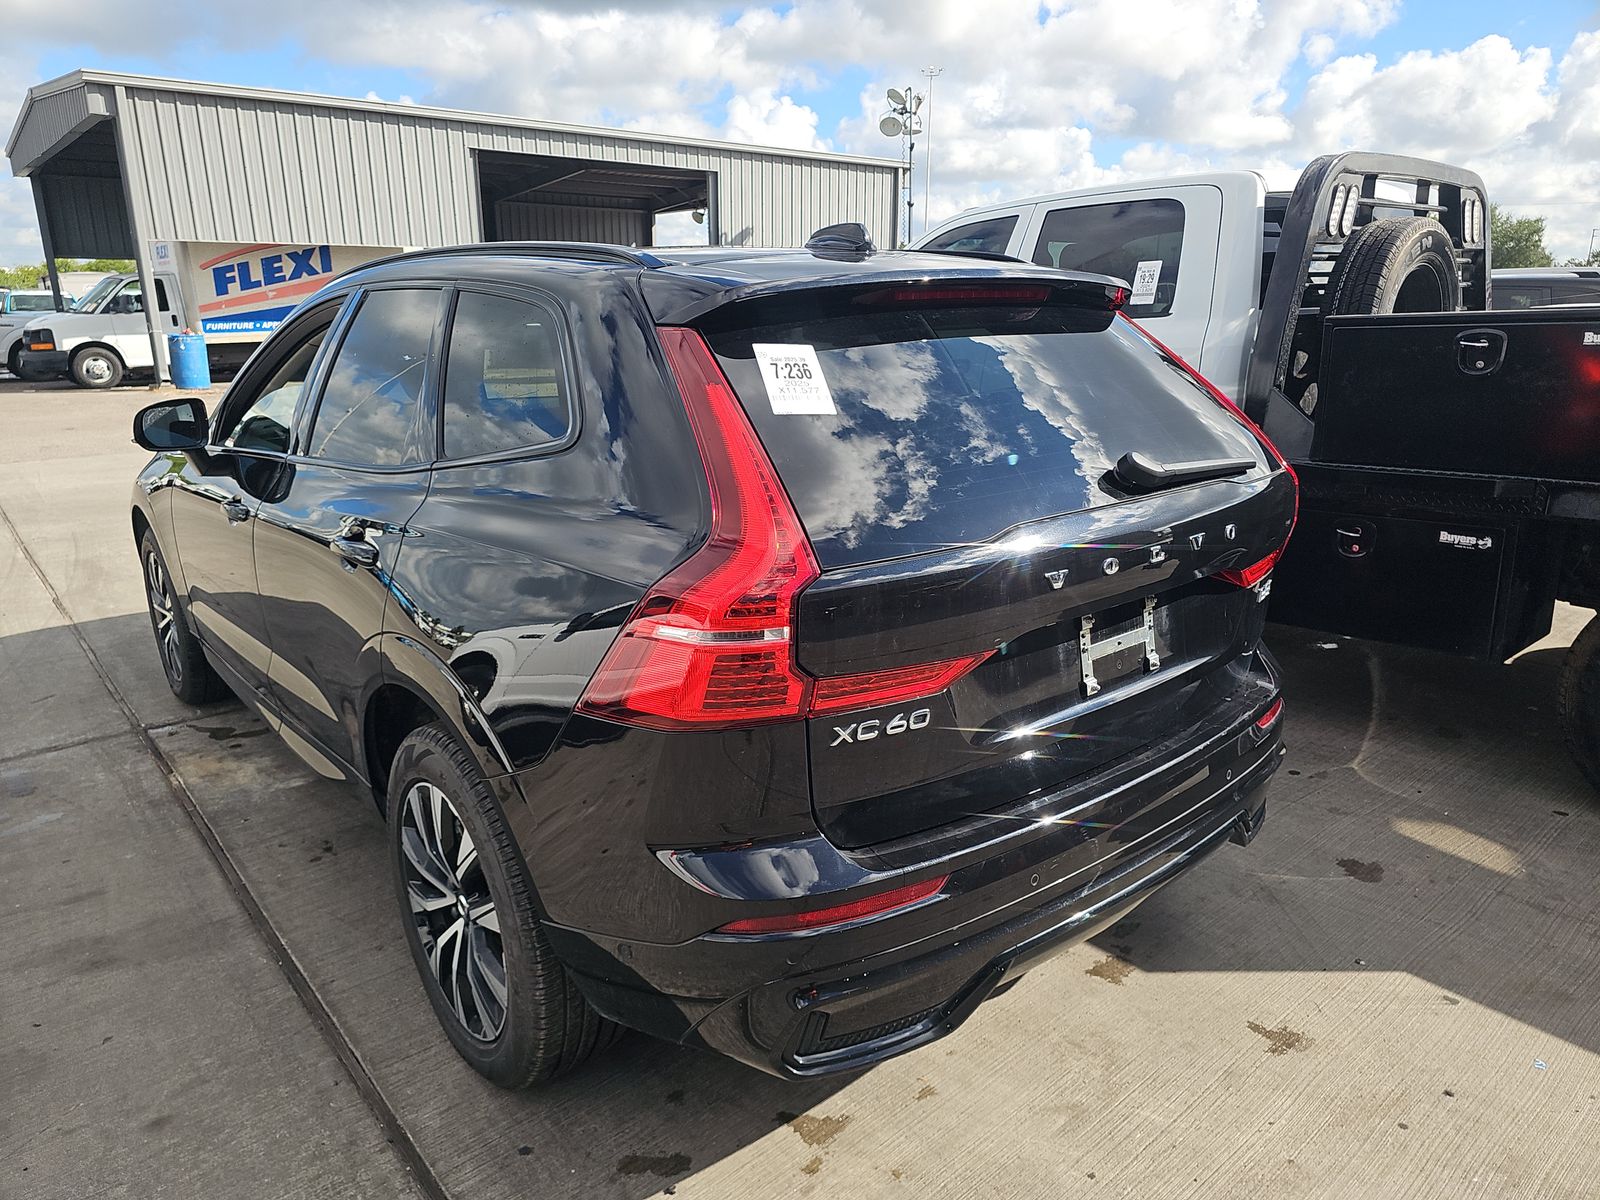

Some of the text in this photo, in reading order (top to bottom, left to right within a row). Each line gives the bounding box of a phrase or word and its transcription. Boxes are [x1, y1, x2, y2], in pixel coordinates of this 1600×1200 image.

[213, 245, 333, 297] FLEXI
[206, 321, 280, 330] FURNITURE APP
[1583, 331, 1600, 343] Bu
[770, 362, 812, 379] 7:236
[1440, 530, 1477, 544] Buyers
[1044, 523, 1236, 590] VOLVO
